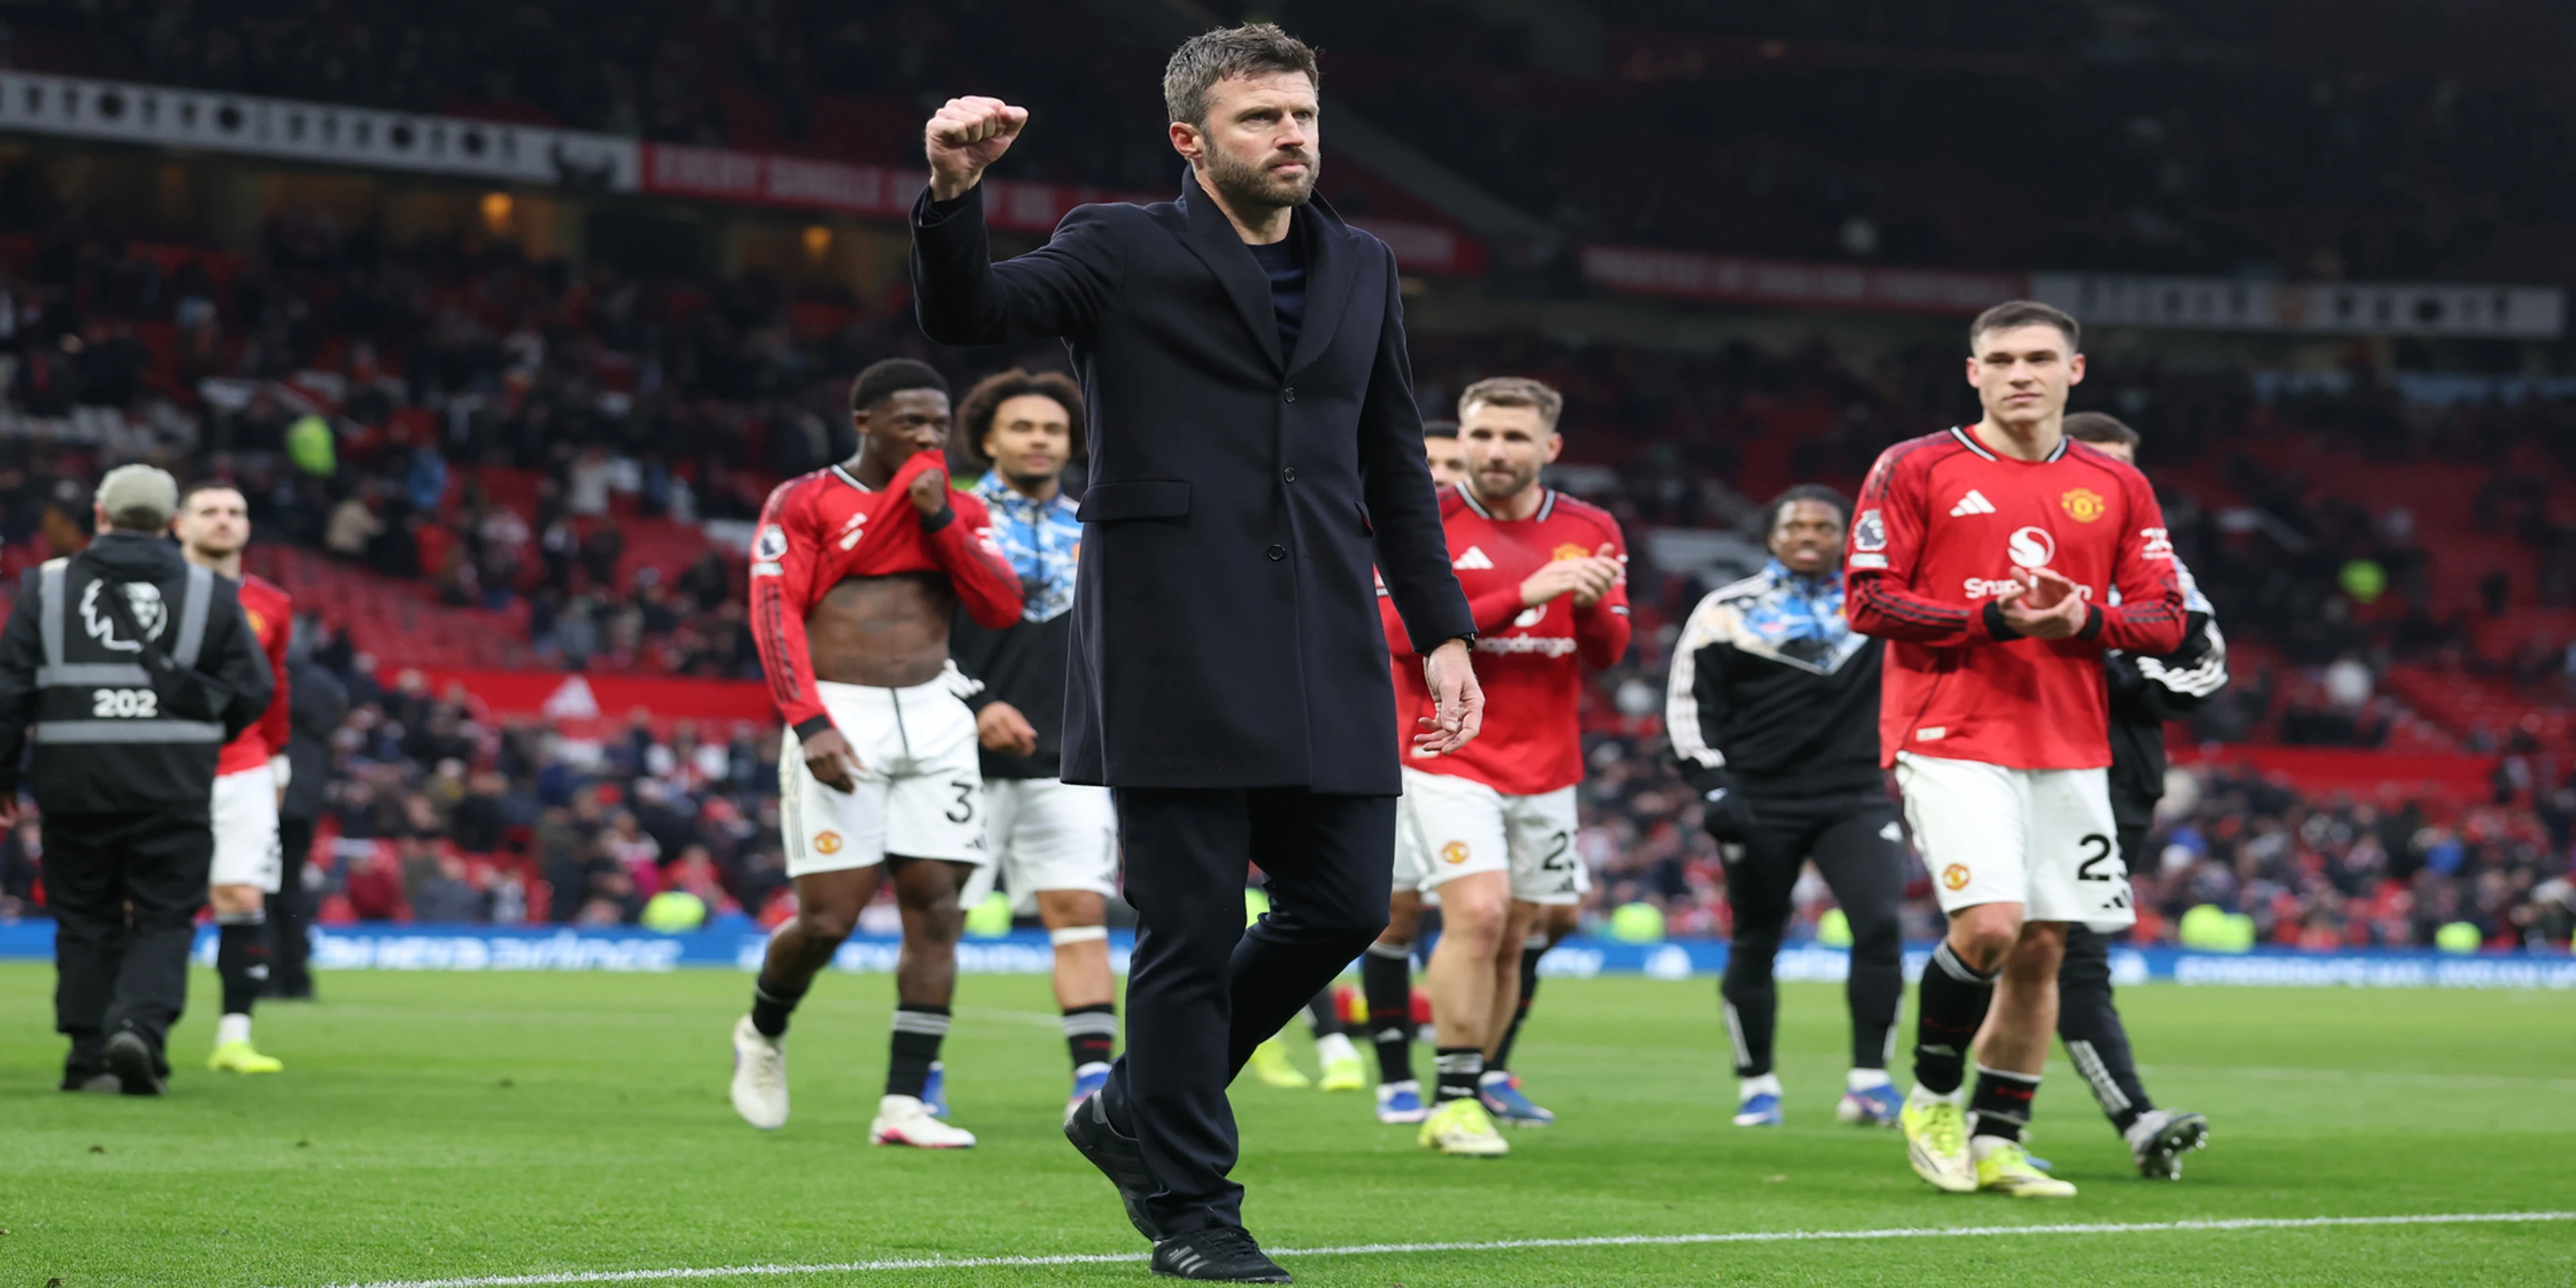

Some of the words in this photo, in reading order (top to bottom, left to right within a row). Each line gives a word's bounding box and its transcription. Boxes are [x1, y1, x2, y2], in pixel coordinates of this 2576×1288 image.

[93, 688, 158, 718] 202
[946, 782, 985, 825] 3
[1542, 830, 1576, 870] 2
[2078, 834, 2125, 881] 2
